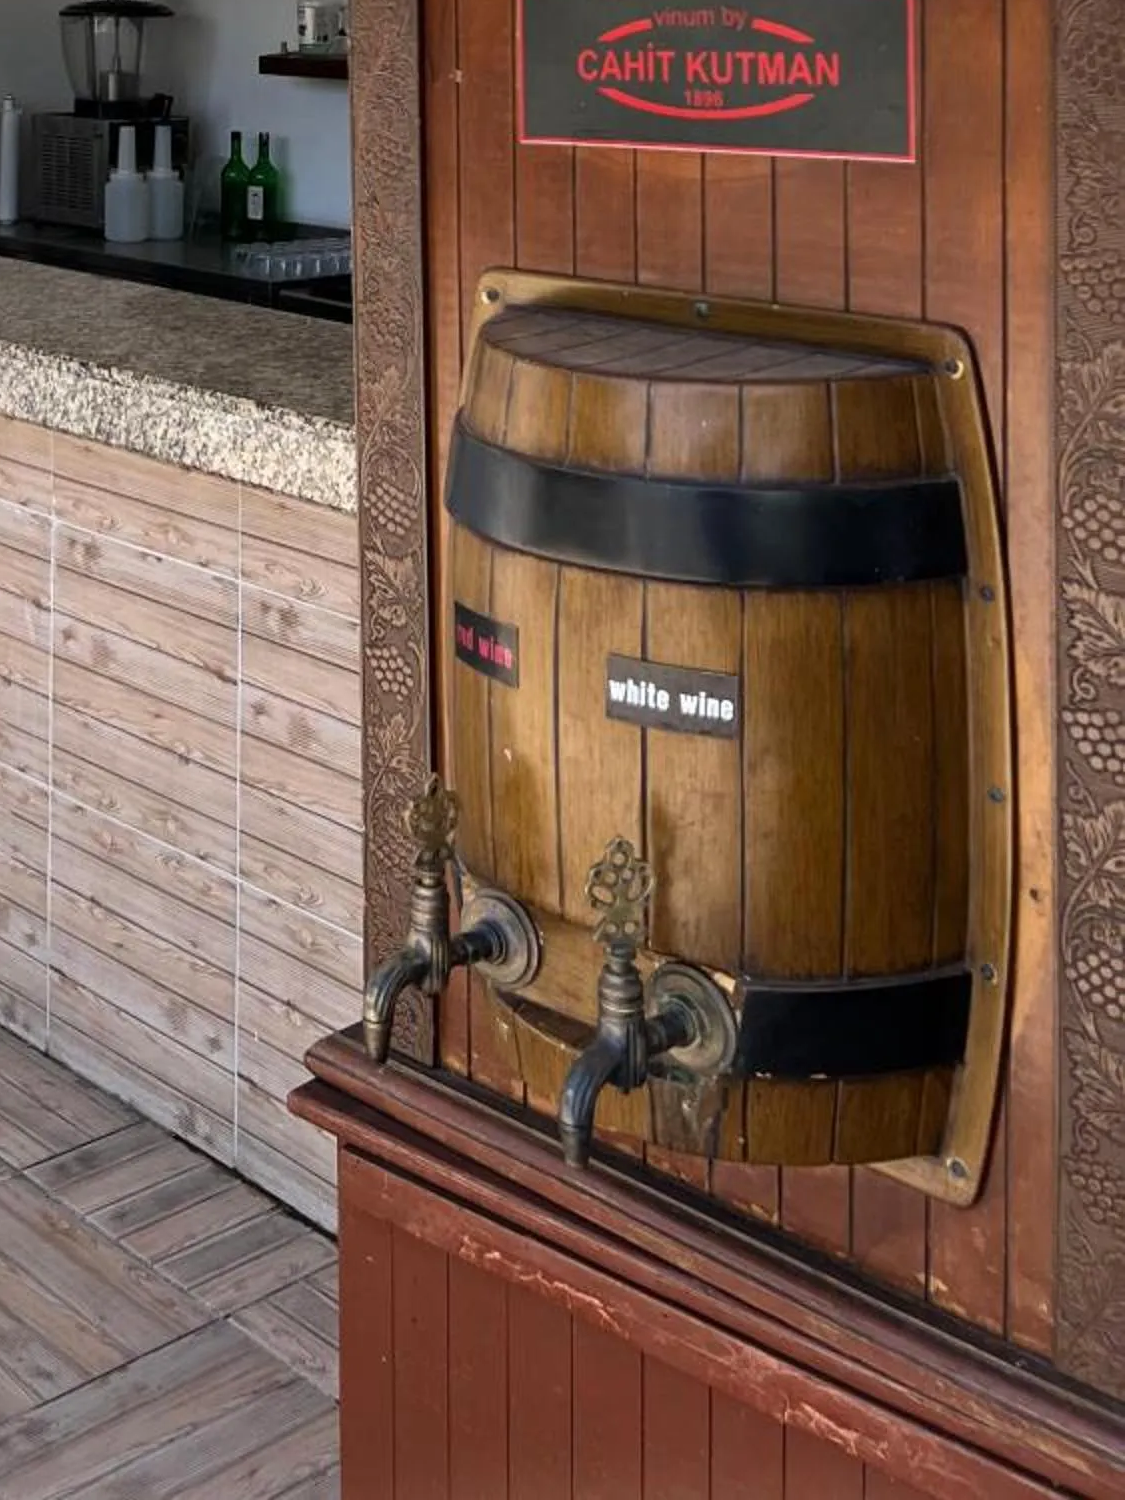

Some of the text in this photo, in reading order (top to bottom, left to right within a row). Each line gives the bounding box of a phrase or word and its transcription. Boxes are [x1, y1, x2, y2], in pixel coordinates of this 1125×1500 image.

[652, 6, 748, 32] vinum by
[577, 41, 840, 86] CAHİT KUTMAN
[608, 678, 735, 722] white wine
